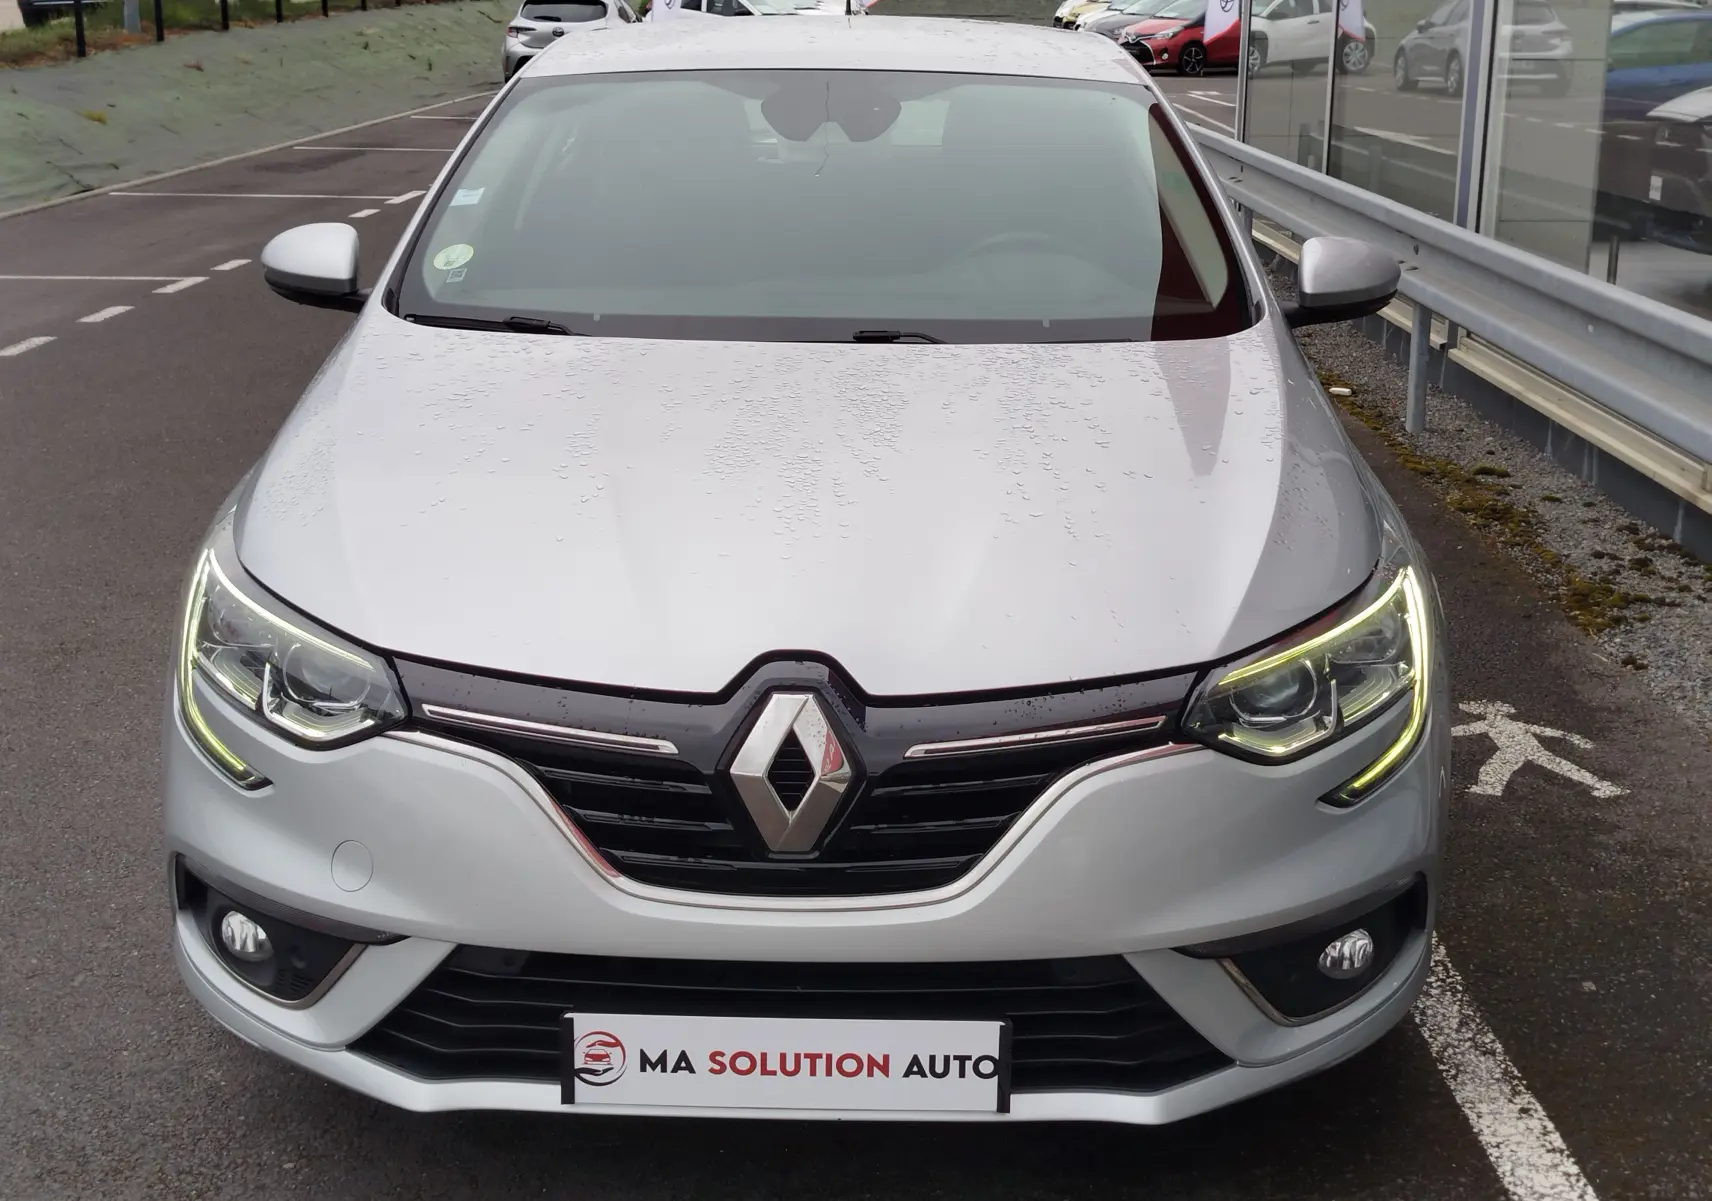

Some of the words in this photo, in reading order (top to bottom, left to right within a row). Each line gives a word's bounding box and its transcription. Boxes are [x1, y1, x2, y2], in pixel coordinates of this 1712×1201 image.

[639, 1048, 697, 1074] MA
[707, 1050, 890, 1078] SOLUTION
[901, 1053, 999, 1079] AUTO
